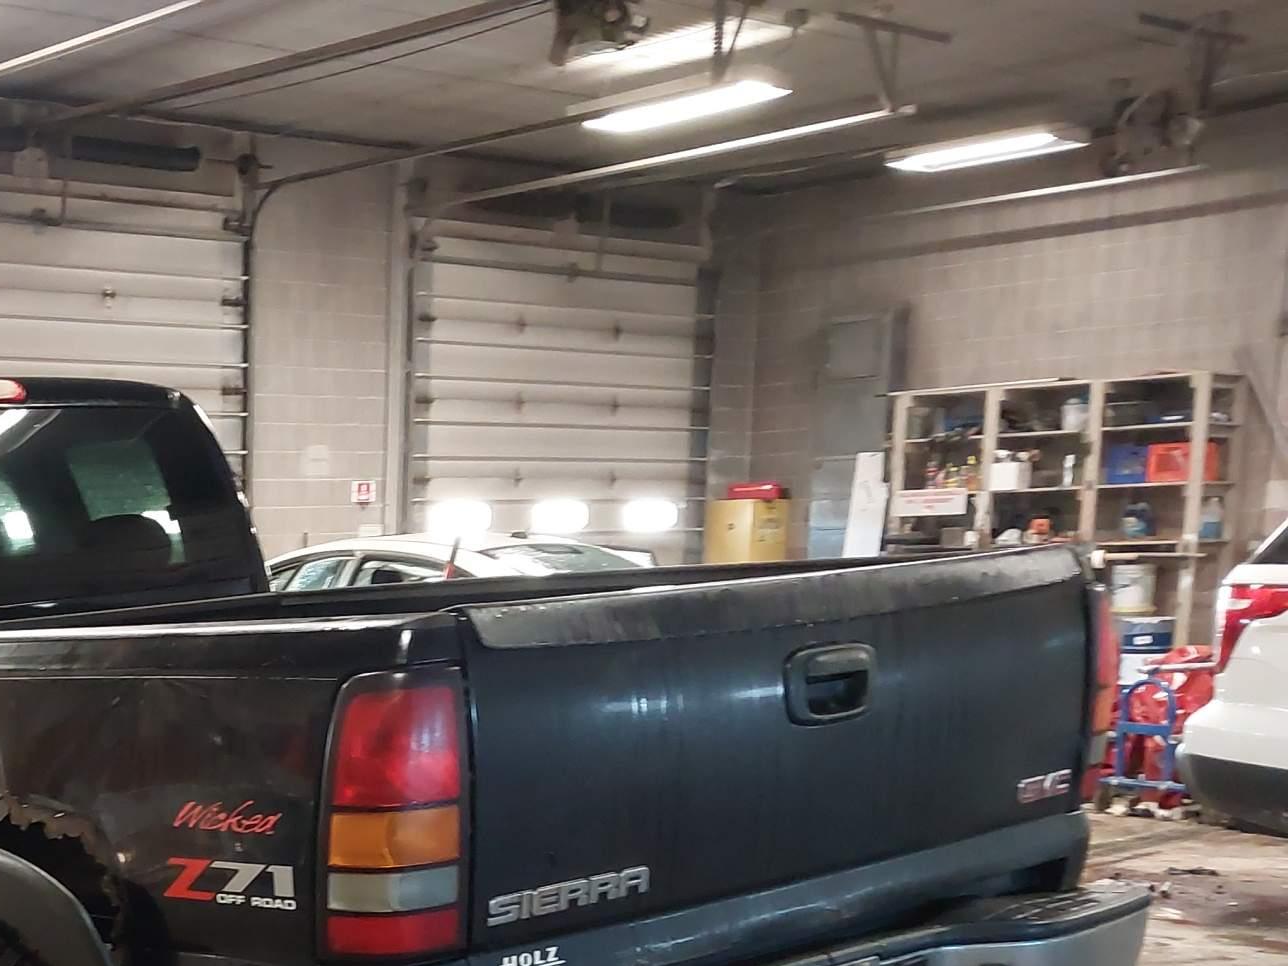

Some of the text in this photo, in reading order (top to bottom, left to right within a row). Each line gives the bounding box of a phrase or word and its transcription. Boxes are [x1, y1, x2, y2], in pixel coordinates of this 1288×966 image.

[173, 800, 283, 836] Wicked
[163, 856, 296, 901] Z71
[486, 864, 651, 928] SIERRA
[215, 893, 298, 911] OFF ROAD
